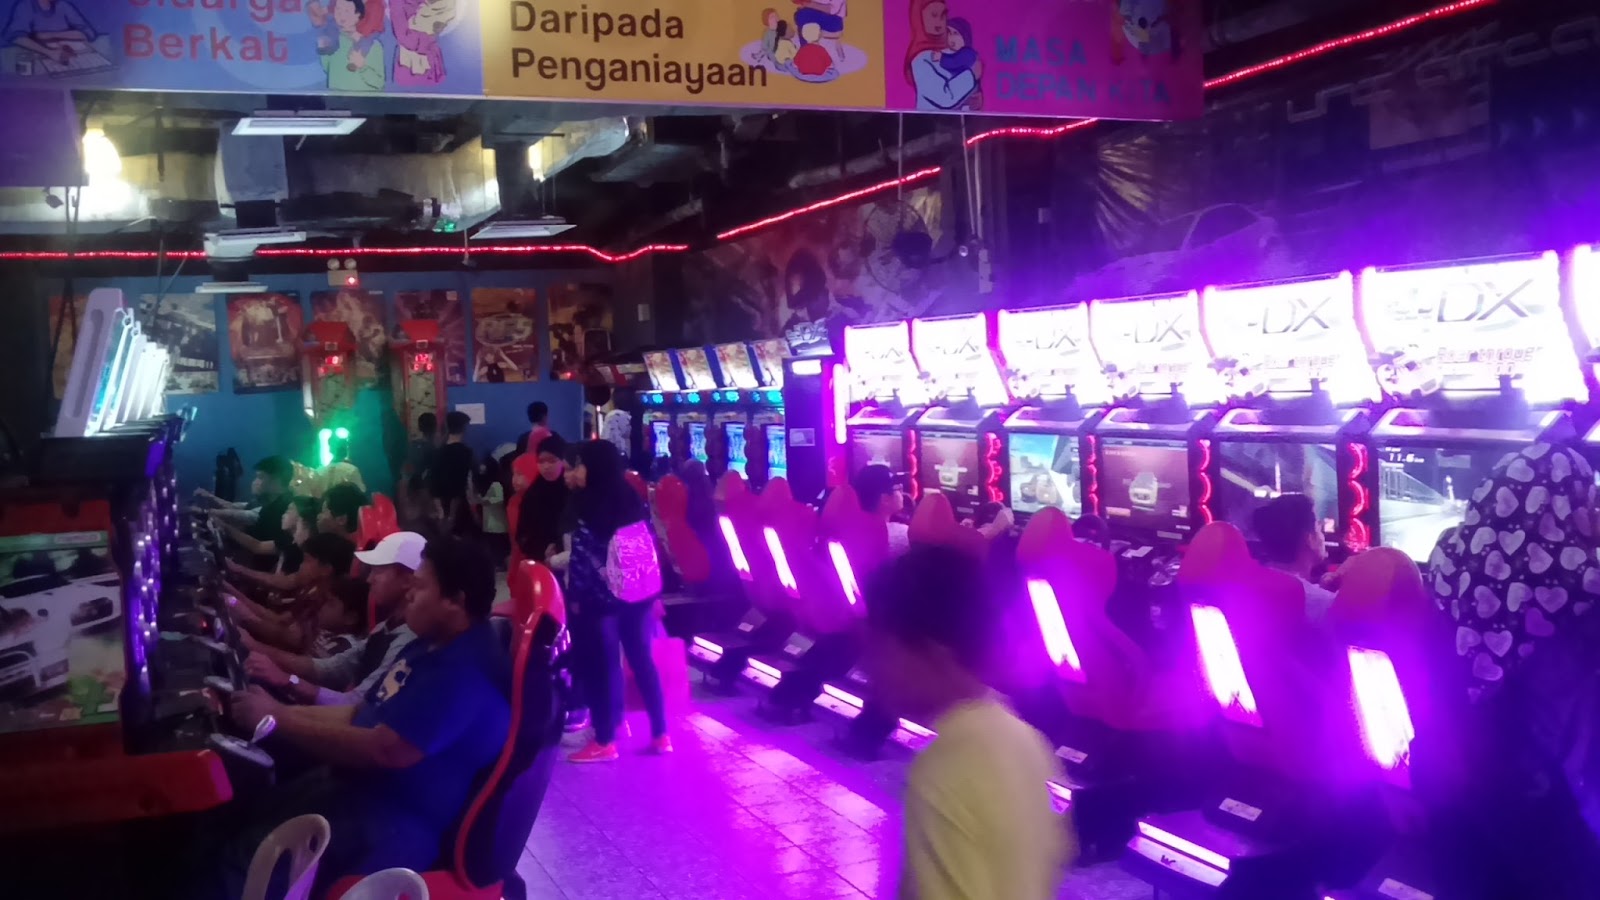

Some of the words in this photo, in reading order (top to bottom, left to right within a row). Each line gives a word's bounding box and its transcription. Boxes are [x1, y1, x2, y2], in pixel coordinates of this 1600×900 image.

[510, 1, 684, 42] Daripada
[123, 23, 288, 63] Berkat
[995, 34, 1087, 67] MASA
[511, 48, 767, 94] Penganiayaan
[997, 71, 1098, 103] DEPAN
